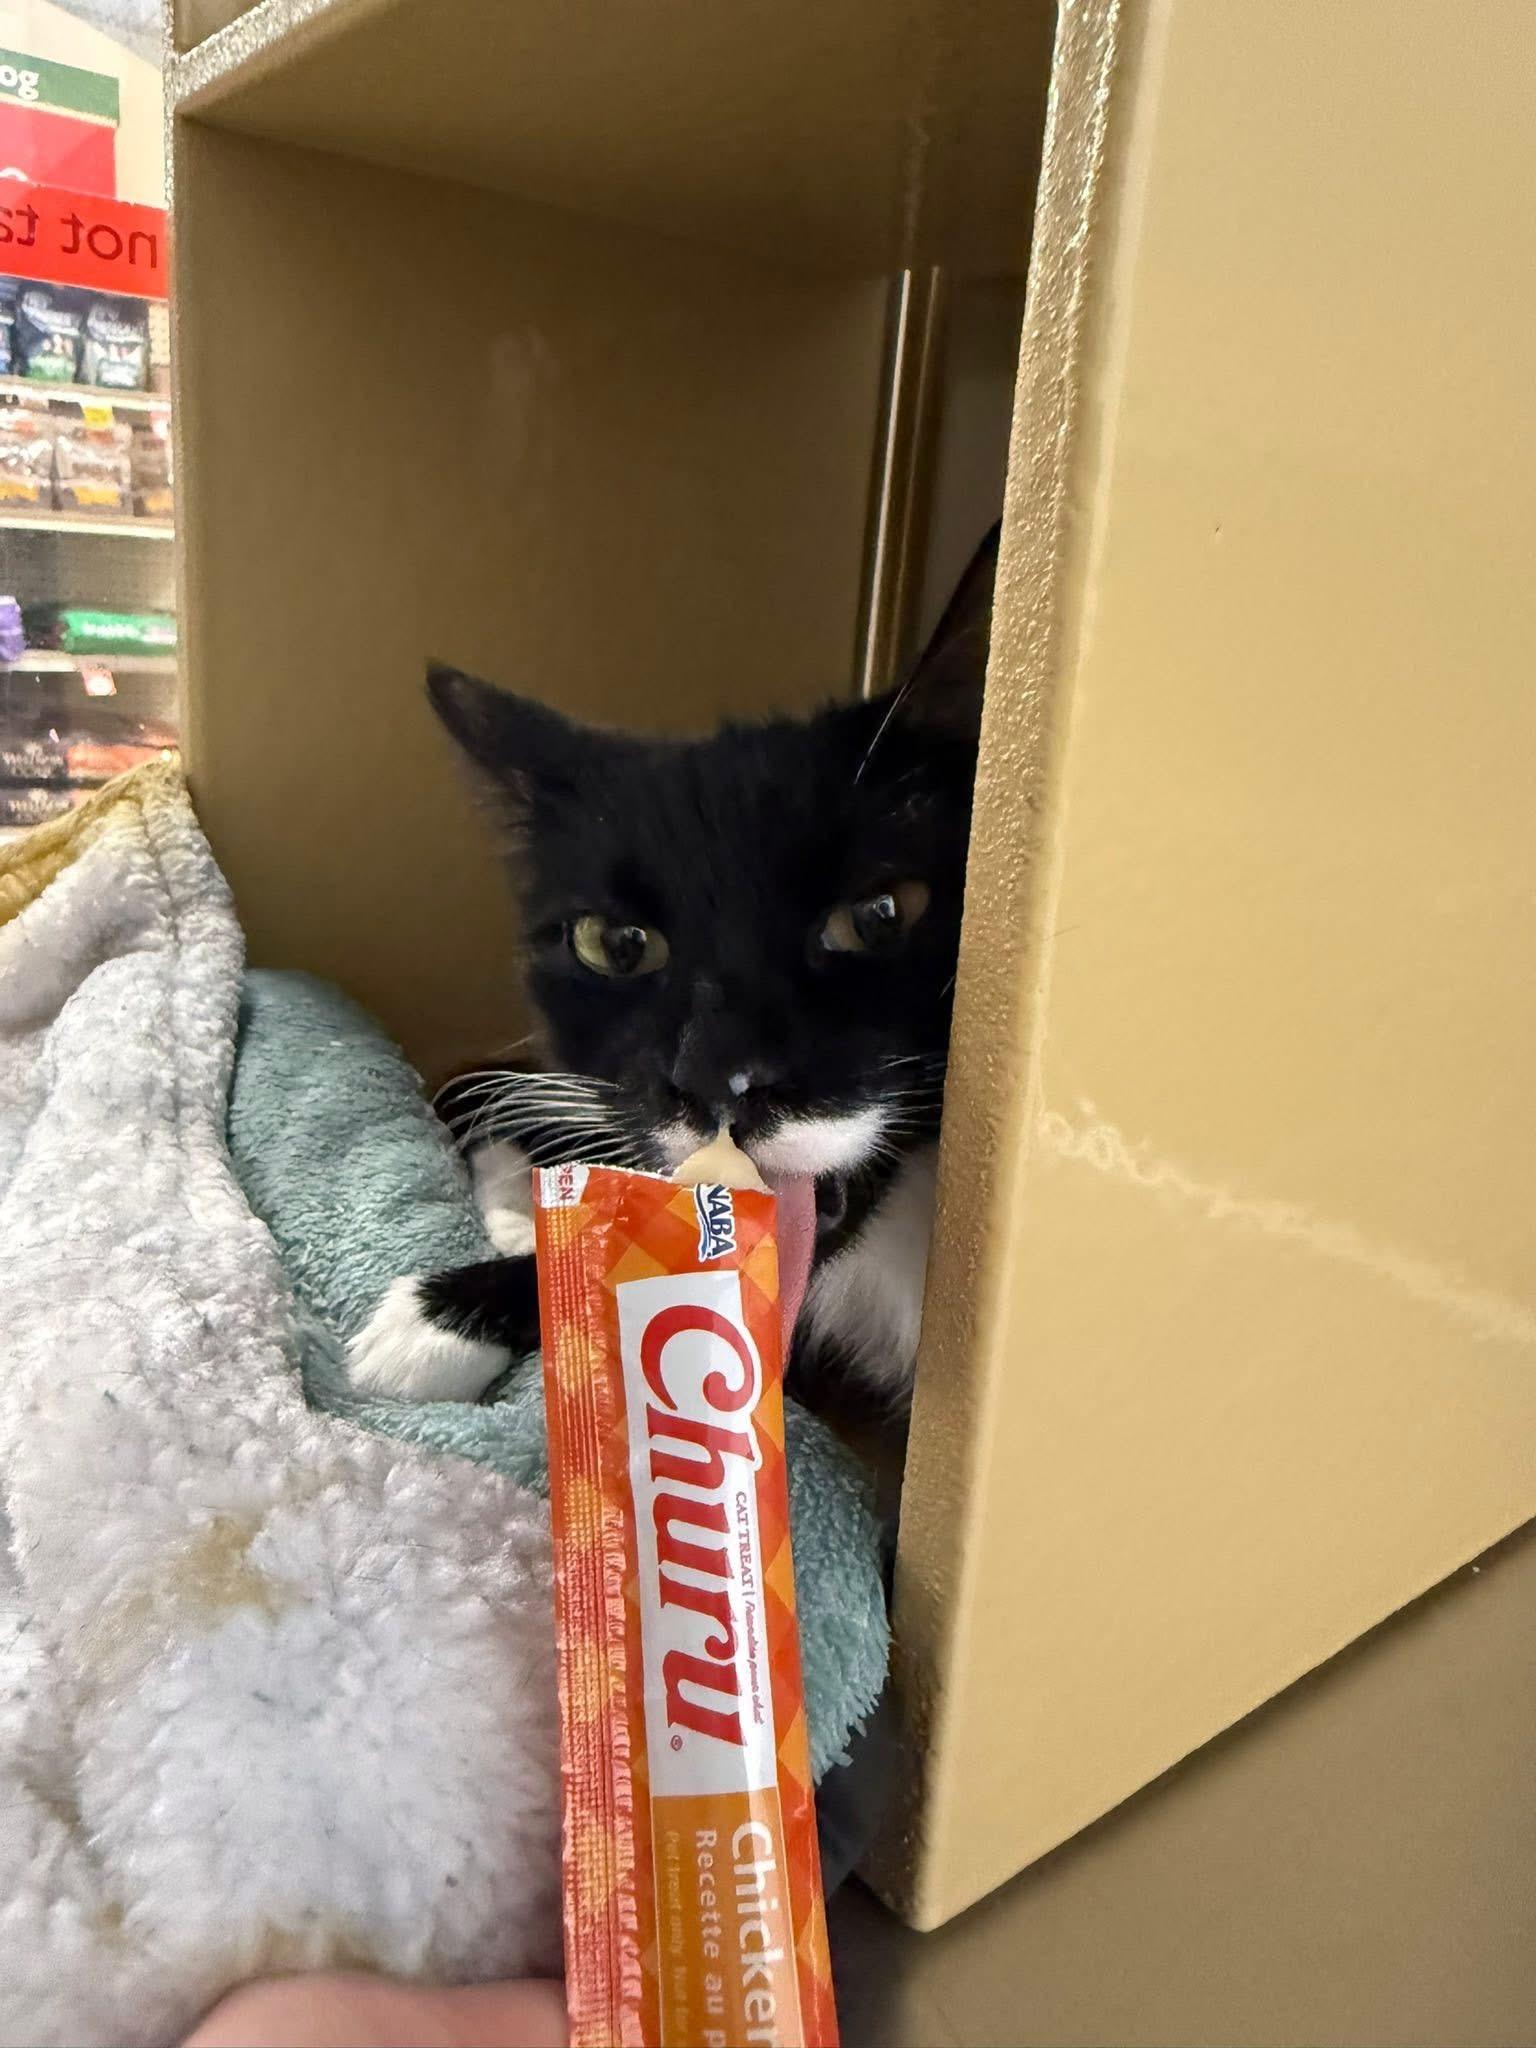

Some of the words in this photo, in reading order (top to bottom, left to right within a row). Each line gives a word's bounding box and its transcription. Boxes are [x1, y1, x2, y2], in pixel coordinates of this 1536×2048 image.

[641, 1305, 755, 1746] Churu
[736, 1491, 749, 1526] CAT
[738, 1529, 754, 1589] TREAT
[696, 1830, 721, 1959] Recette
[704, 1973, 724, 2014] au
